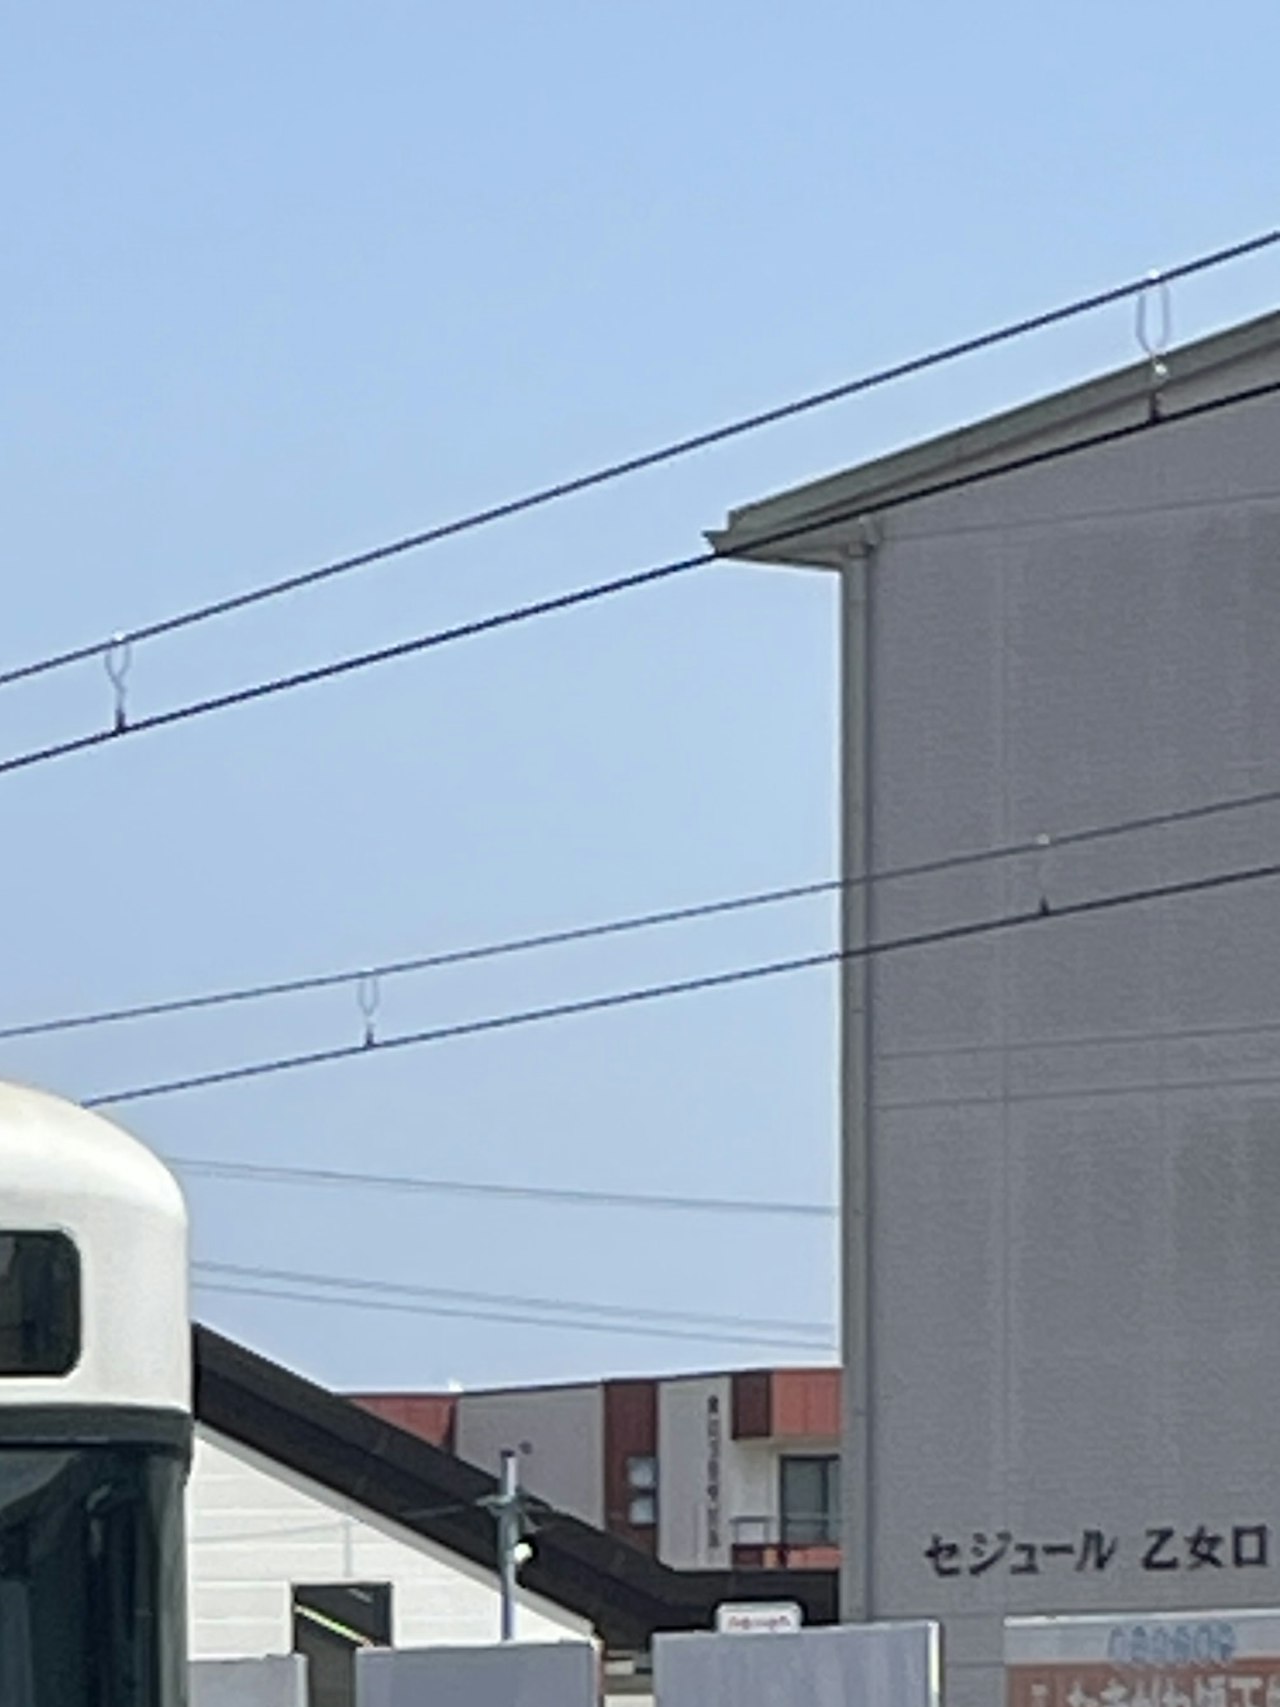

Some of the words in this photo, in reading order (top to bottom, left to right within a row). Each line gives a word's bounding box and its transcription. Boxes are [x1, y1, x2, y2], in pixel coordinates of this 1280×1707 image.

[924, 1529, 1118, 1578] セジュール
